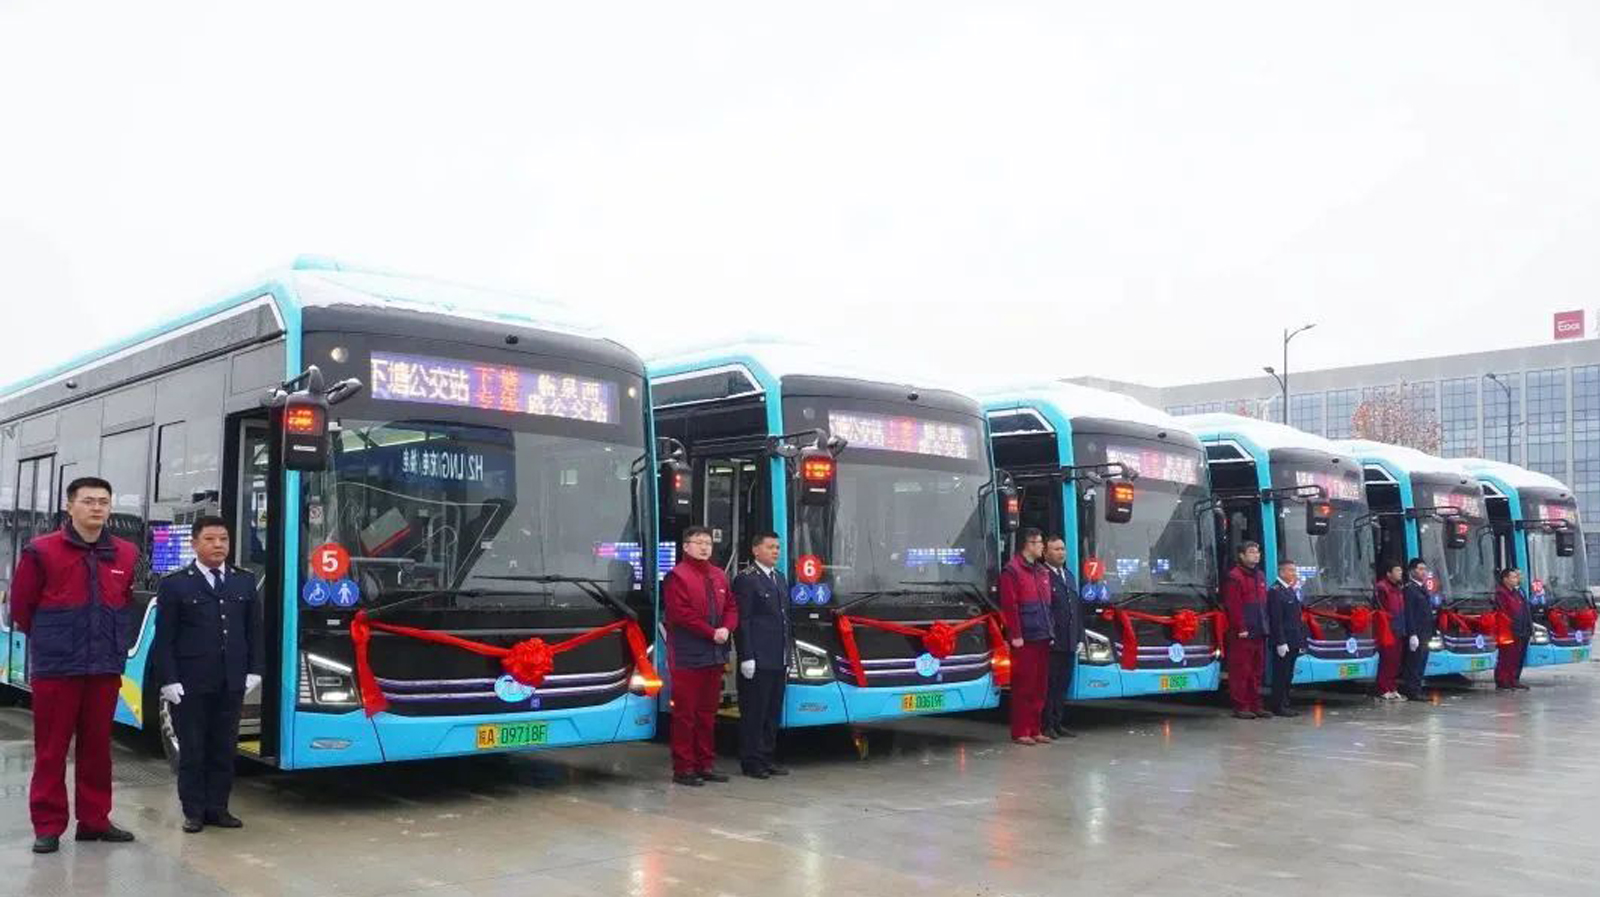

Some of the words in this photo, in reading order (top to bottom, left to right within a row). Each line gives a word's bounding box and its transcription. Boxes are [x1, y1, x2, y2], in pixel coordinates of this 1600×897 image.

[370, 358, 470, 403] 下塘公交站
[322, 550, 338, 573] 5
[803, 559, 815, 577] 6
[1089, 560, 1098, 575] 7
[500, 723, 548, 744] 09718F
